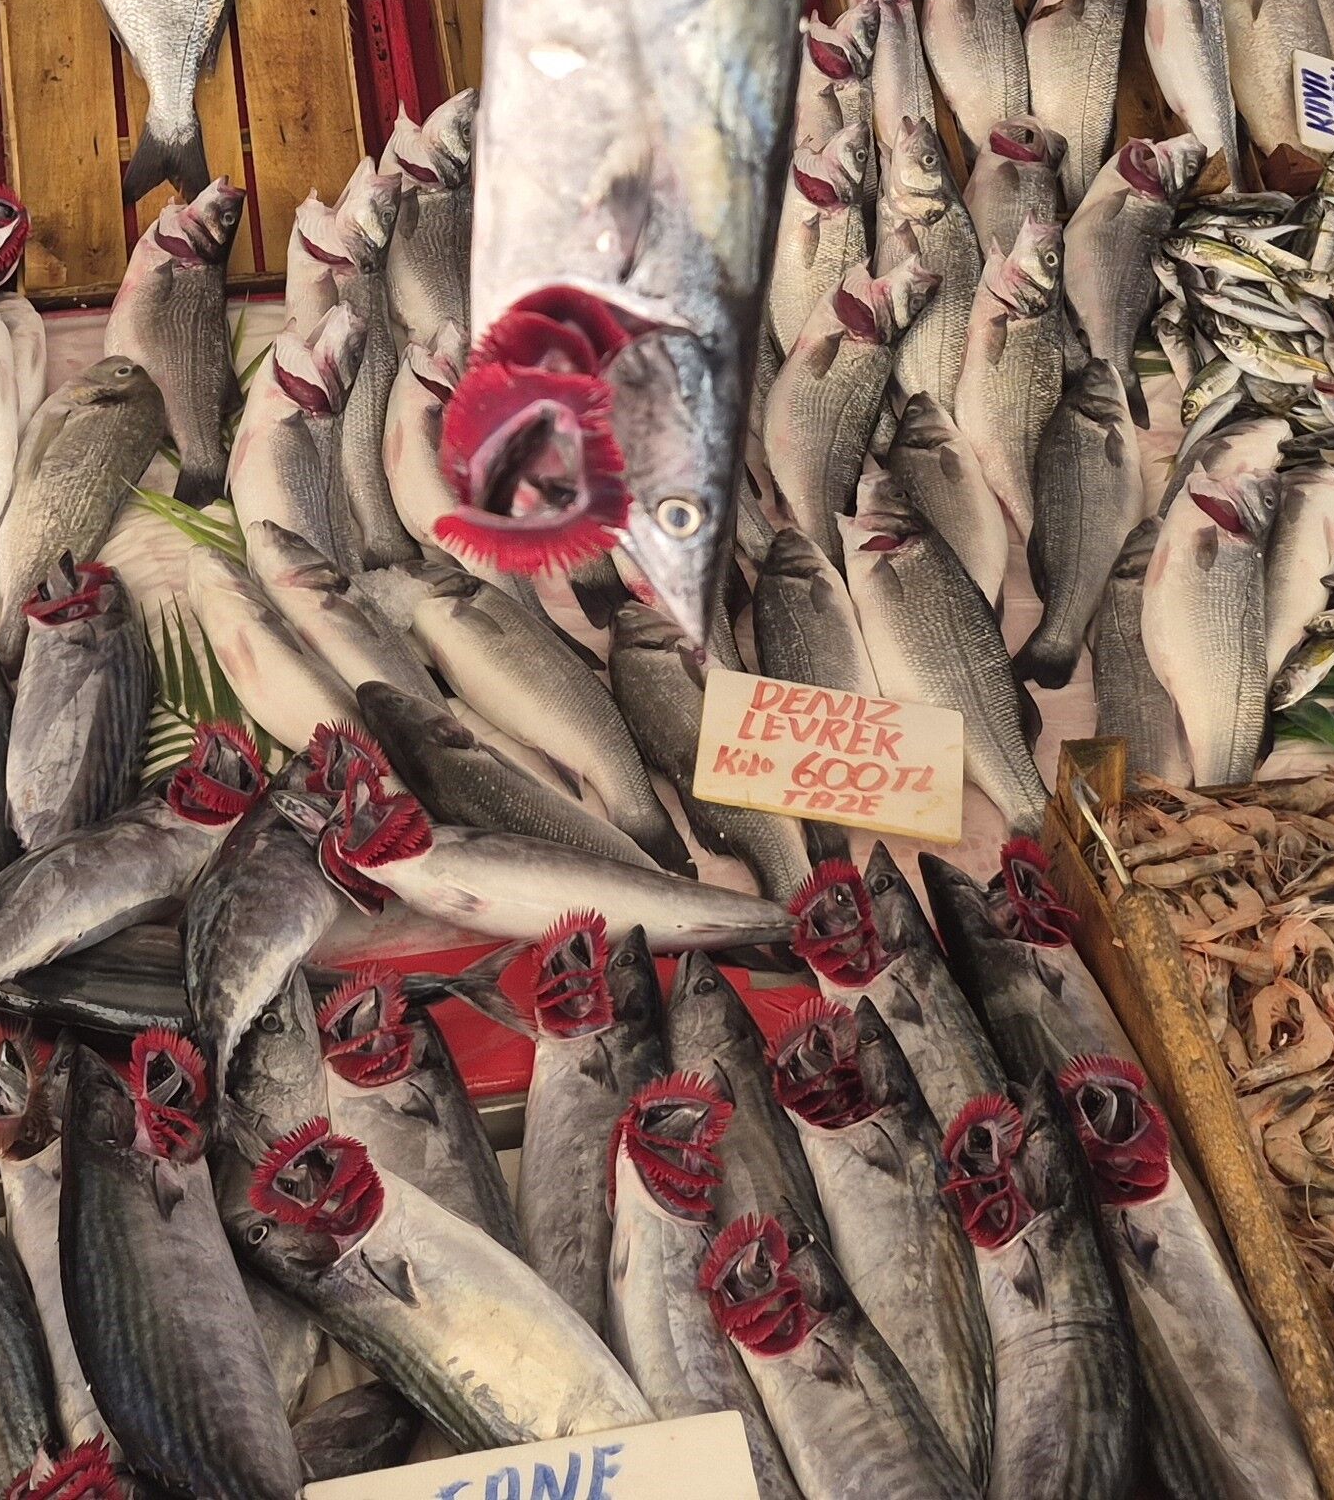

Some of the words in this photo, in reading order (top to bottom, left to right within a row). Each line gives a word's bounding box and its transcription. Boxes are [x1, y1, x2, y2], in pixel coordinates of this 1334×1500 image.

[750, 679, 902, 728] DENIZ
[738, 710, 904, 762] LEVREK
[790, 750, 890, 793] 600
[781, 789, 884, 816] TAZE
